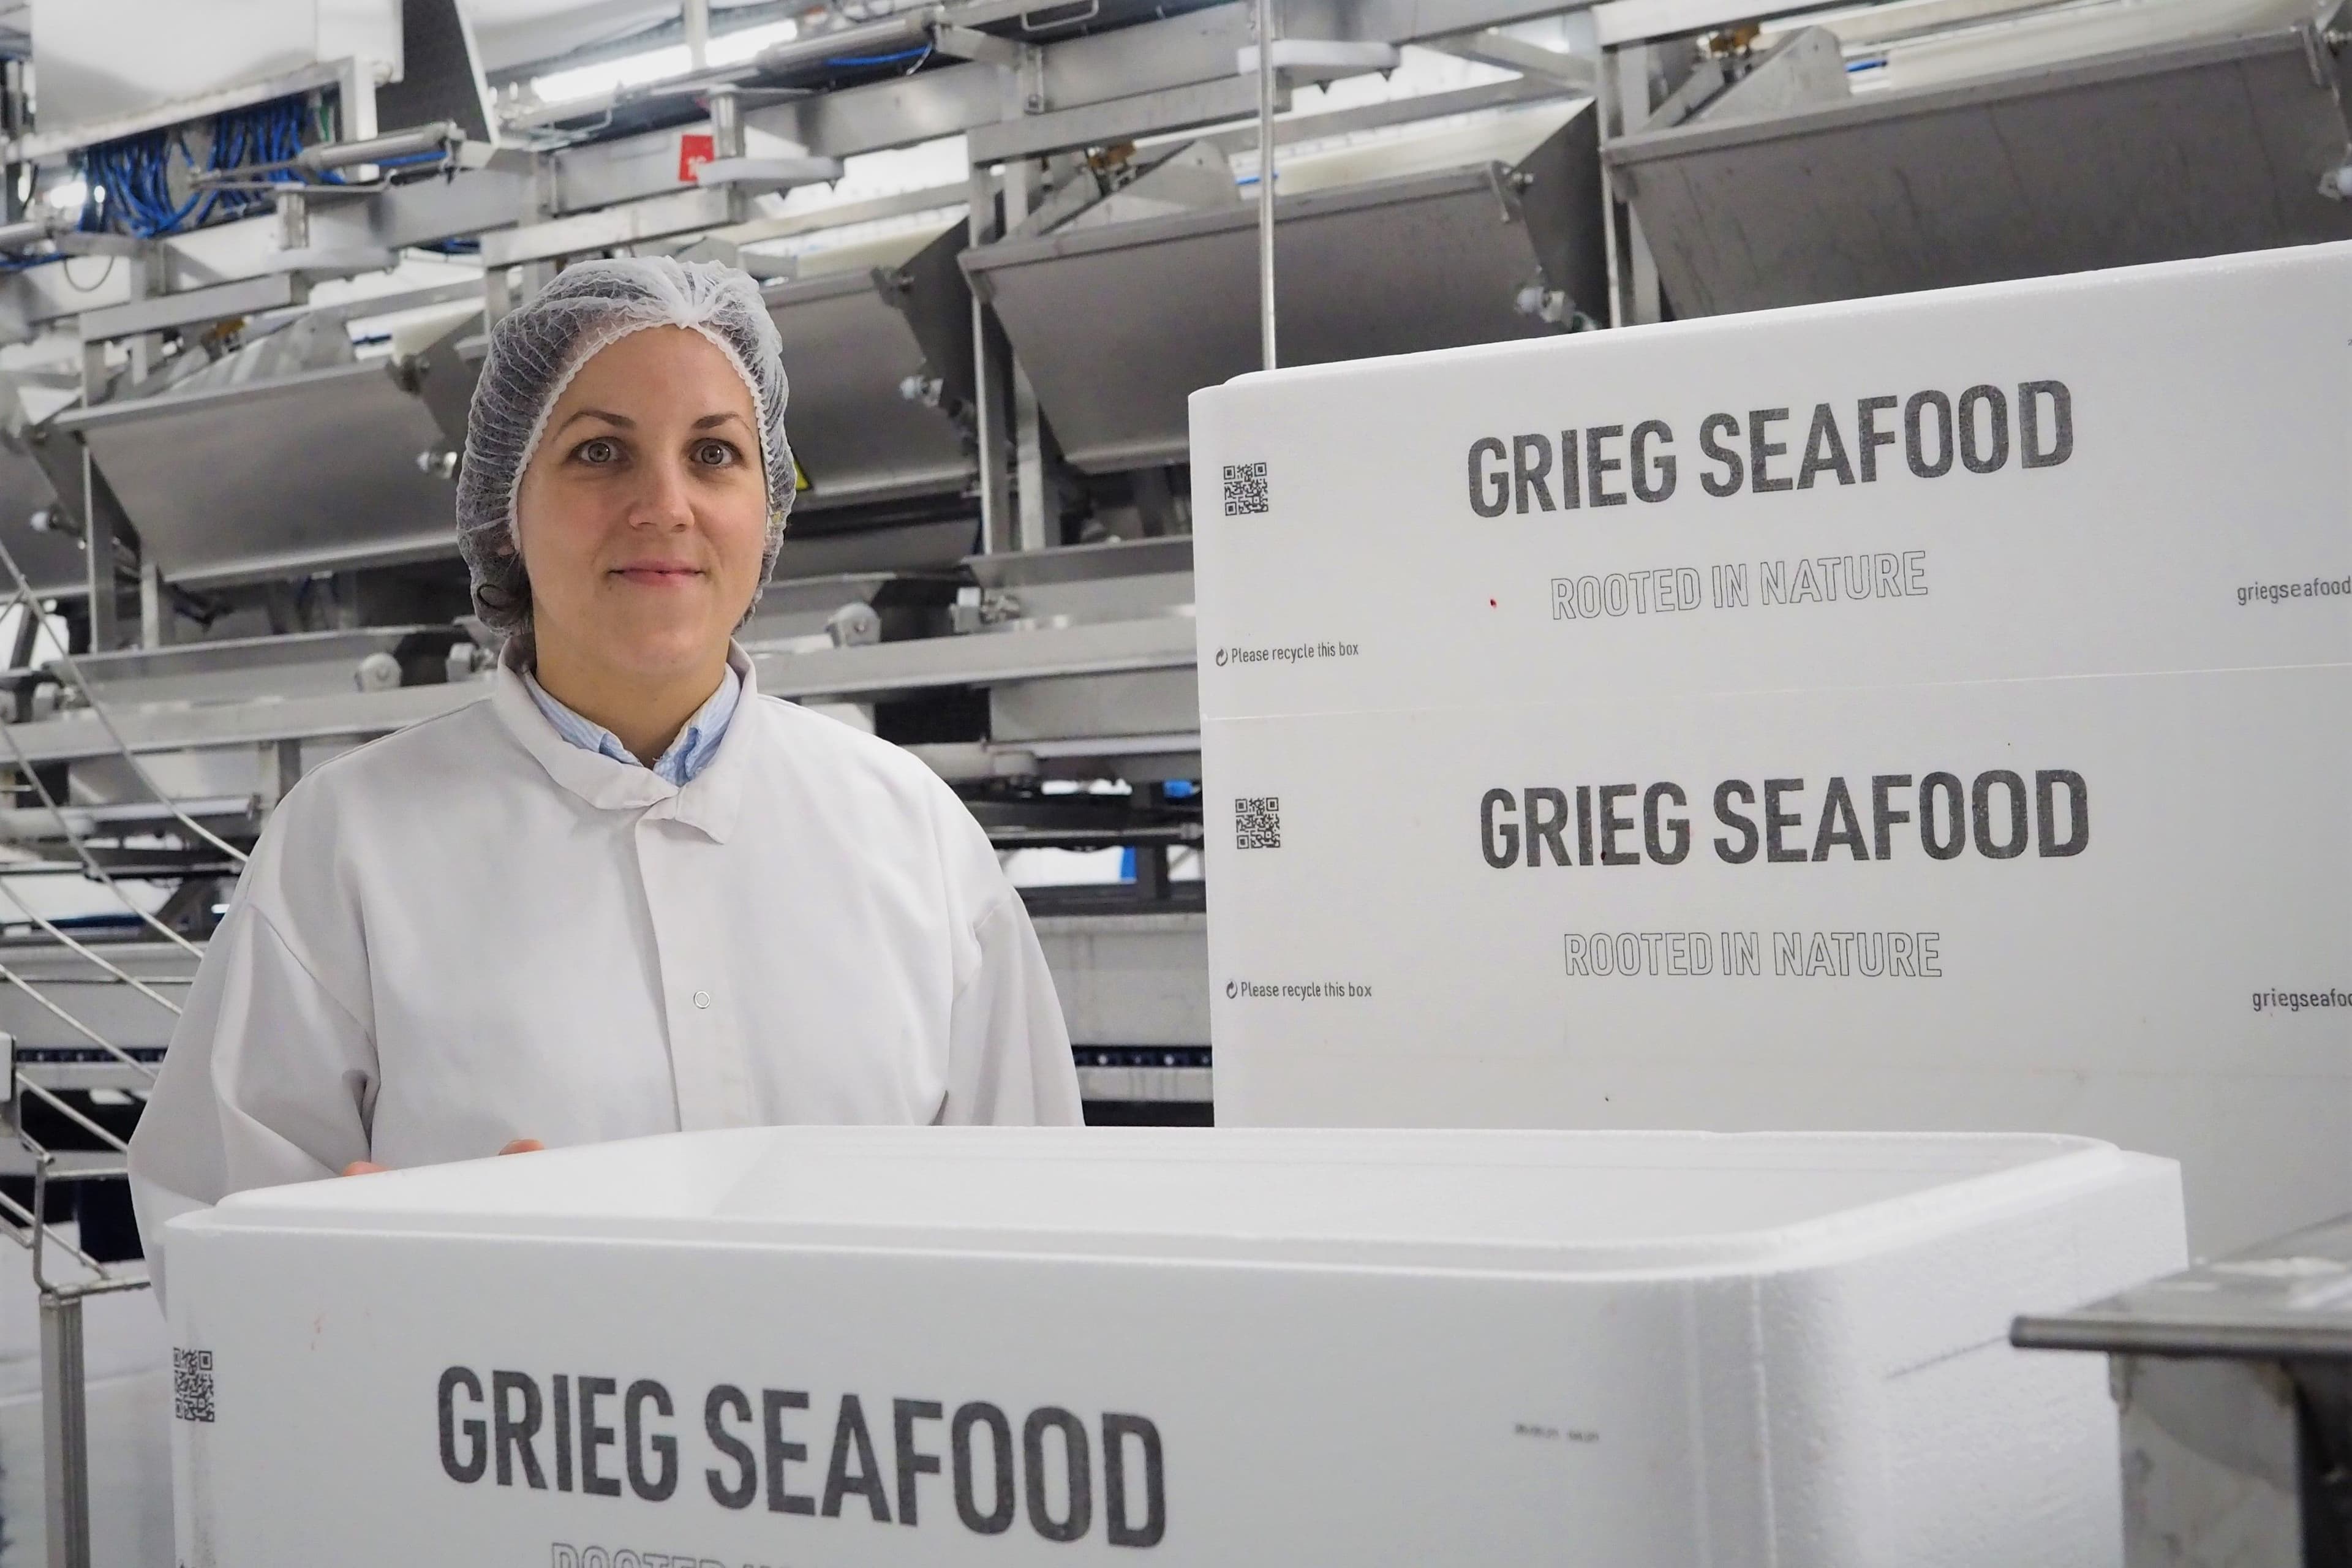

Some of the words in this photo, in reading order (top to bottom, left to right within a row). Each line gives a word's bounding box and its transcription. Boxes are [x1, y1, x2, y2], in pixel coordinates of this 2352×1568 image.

[1468, 419, 1677, 518] GRIEG
[1699, 380, 2074, 497] SEAFOOD
[1550, 567, 1702, 620] ROOTED
[1711, 563, 1749, 609] IN
[1760, 549, 1929, 606] NATURE
[1231, 647, 1269, 663] Please
[1272, 643, 1314, 664] recycle
[1317, 641, 1336, 658] this
[1338, 641, 1359, 657] box
[1480, 781, 1691, 869] GRIEG
[1713, 769, 2089, 865] SEAFOOD
[1564, 932, 1714, 977] ROOTED
[1721, 930, 1761, 976] IN
[1773, 931, 1943, 978] NATURE
[1240, 981, 1280, 997] Please
[1281, 981, 1321, 1002] recycle
[1323, 981, 1345, 997] this
[1348, 981, 1373, 997] box
[437, 1366, 679, 1502] GRIEG
[704, 1383, 1167, 1550] SEAFOOD
